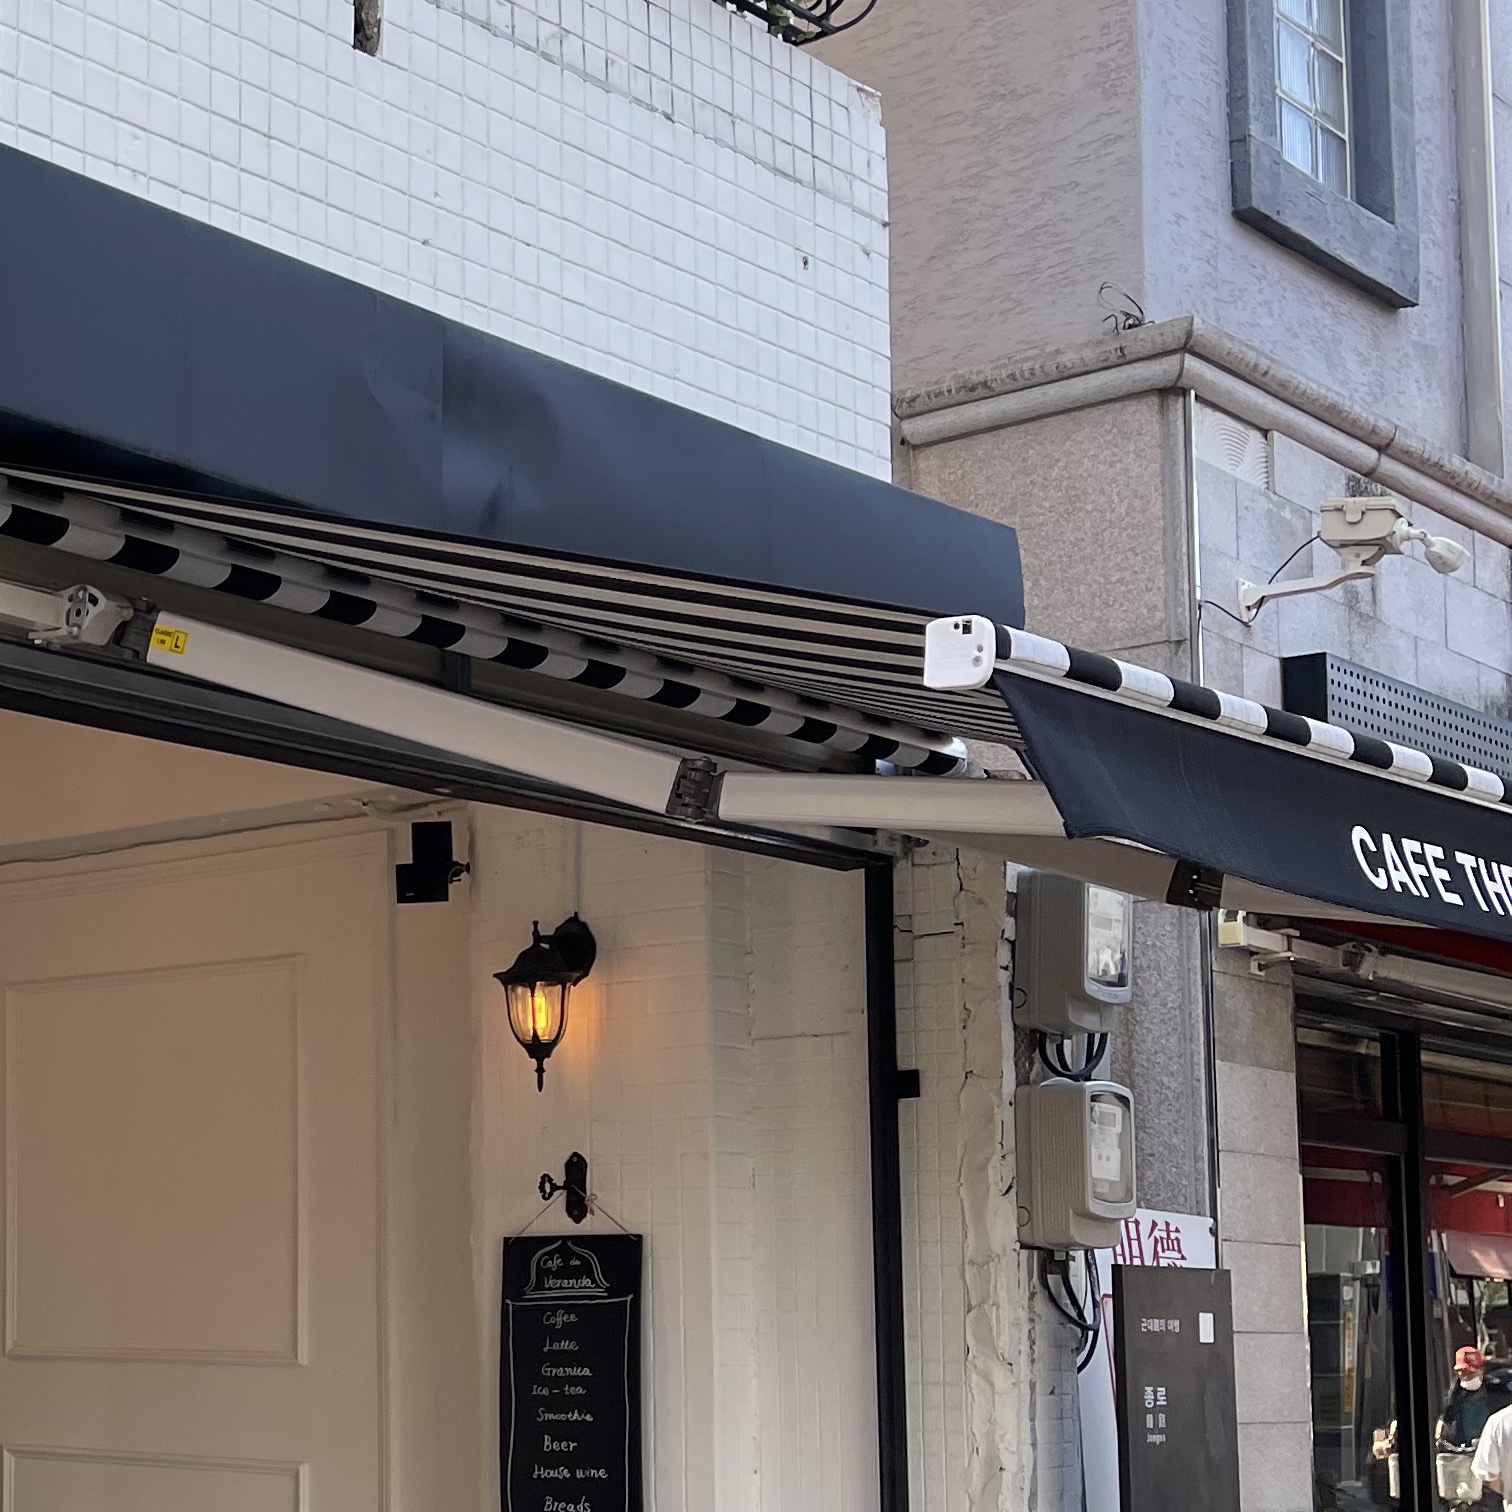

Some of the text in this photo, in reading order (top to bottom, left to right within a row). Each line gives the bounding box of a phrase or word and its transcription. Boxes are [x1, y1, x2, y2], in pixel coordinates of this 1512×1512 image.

[1351, 825, 1464, 906] CAFE
[544, 1274, 595, 1289] Veranda
[542, 1309, 578, 1329] Coffee
[543, 1335, 579, 1352] Latte
[1144, 1385, 1168, 1409] 종로
[536, 1407, 594, 1422] Smoothie
[543, 1434, 578, 1452] Beer
[532, 1463, 609, 1480] House wine
